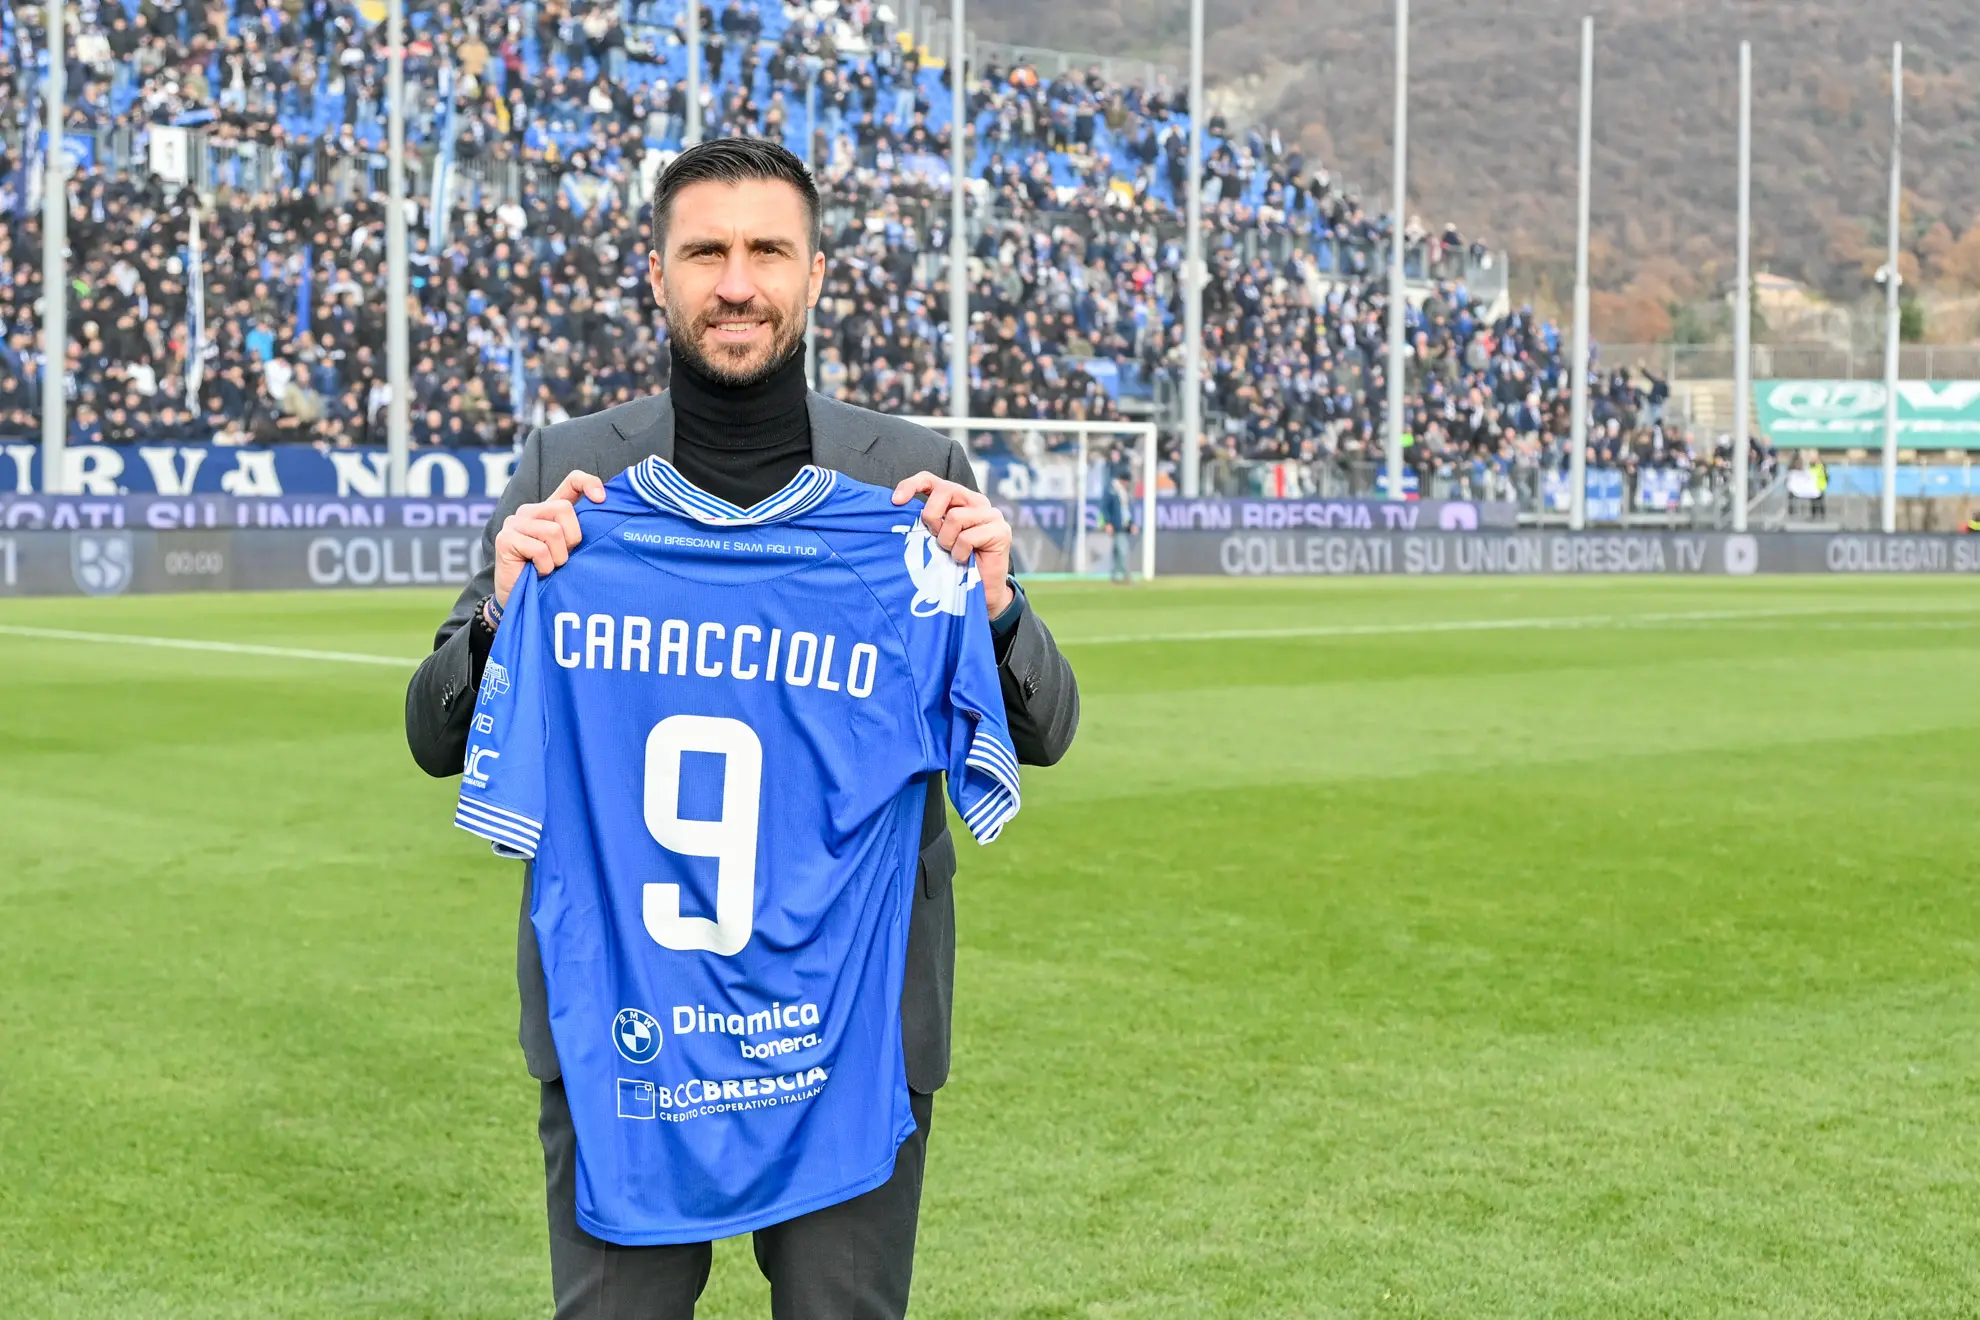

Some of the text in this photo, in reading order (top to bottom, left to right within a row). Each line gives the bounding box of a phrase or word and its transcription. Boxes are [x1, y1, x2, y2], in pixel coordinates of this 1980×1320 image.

[623, 532, 817, 556] SIAMO BRESCIANI E SIAM FIGLI TUOI
[1219, 536, 1707, 575] COLLEGATI SU UNION BRESCIA TV
[1826, 537, 1948, 573] COLLEGATI
[554, 612, 878, 698] CARACCIOLO
[643, 715, 763, 957] 9
[618, 1011, 656, 1029] BMW
[672, 1001, 820, 1037] Dinamica
[740, 1033, 823, 1060] bonera.
[659, 1110, 699, 1124] CREDITO
[700, 1097, 777, 1116] COOPERATIVO
